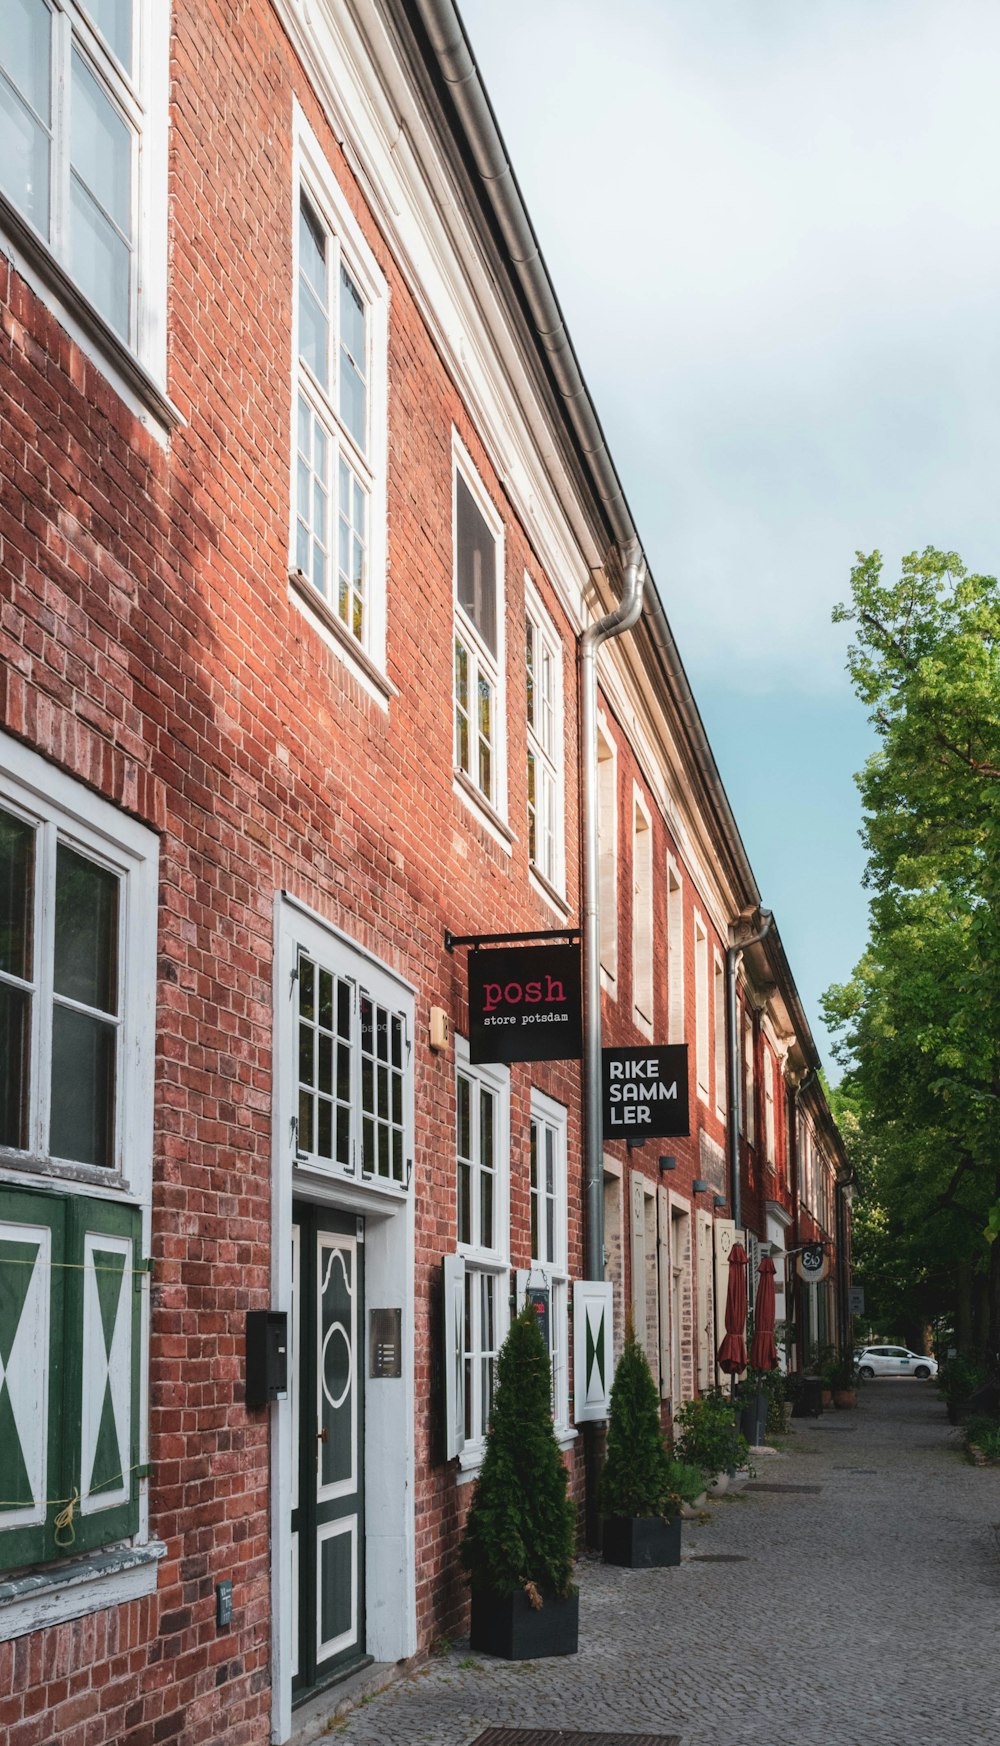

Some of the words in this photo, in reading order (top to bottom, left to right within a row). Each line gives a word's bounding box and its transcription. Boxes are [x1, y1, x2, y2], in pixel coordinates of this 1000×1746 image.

[482, 975, 567, 1011] posh
[483, 1015, 517, 1026] store
[521, 1012, 569, 1026] potsdam
[609, 1059, 659, 1079] RIKE
[609, 1080, 678, 1102] SAMM
[610, 1105, 652, 1125] LER
